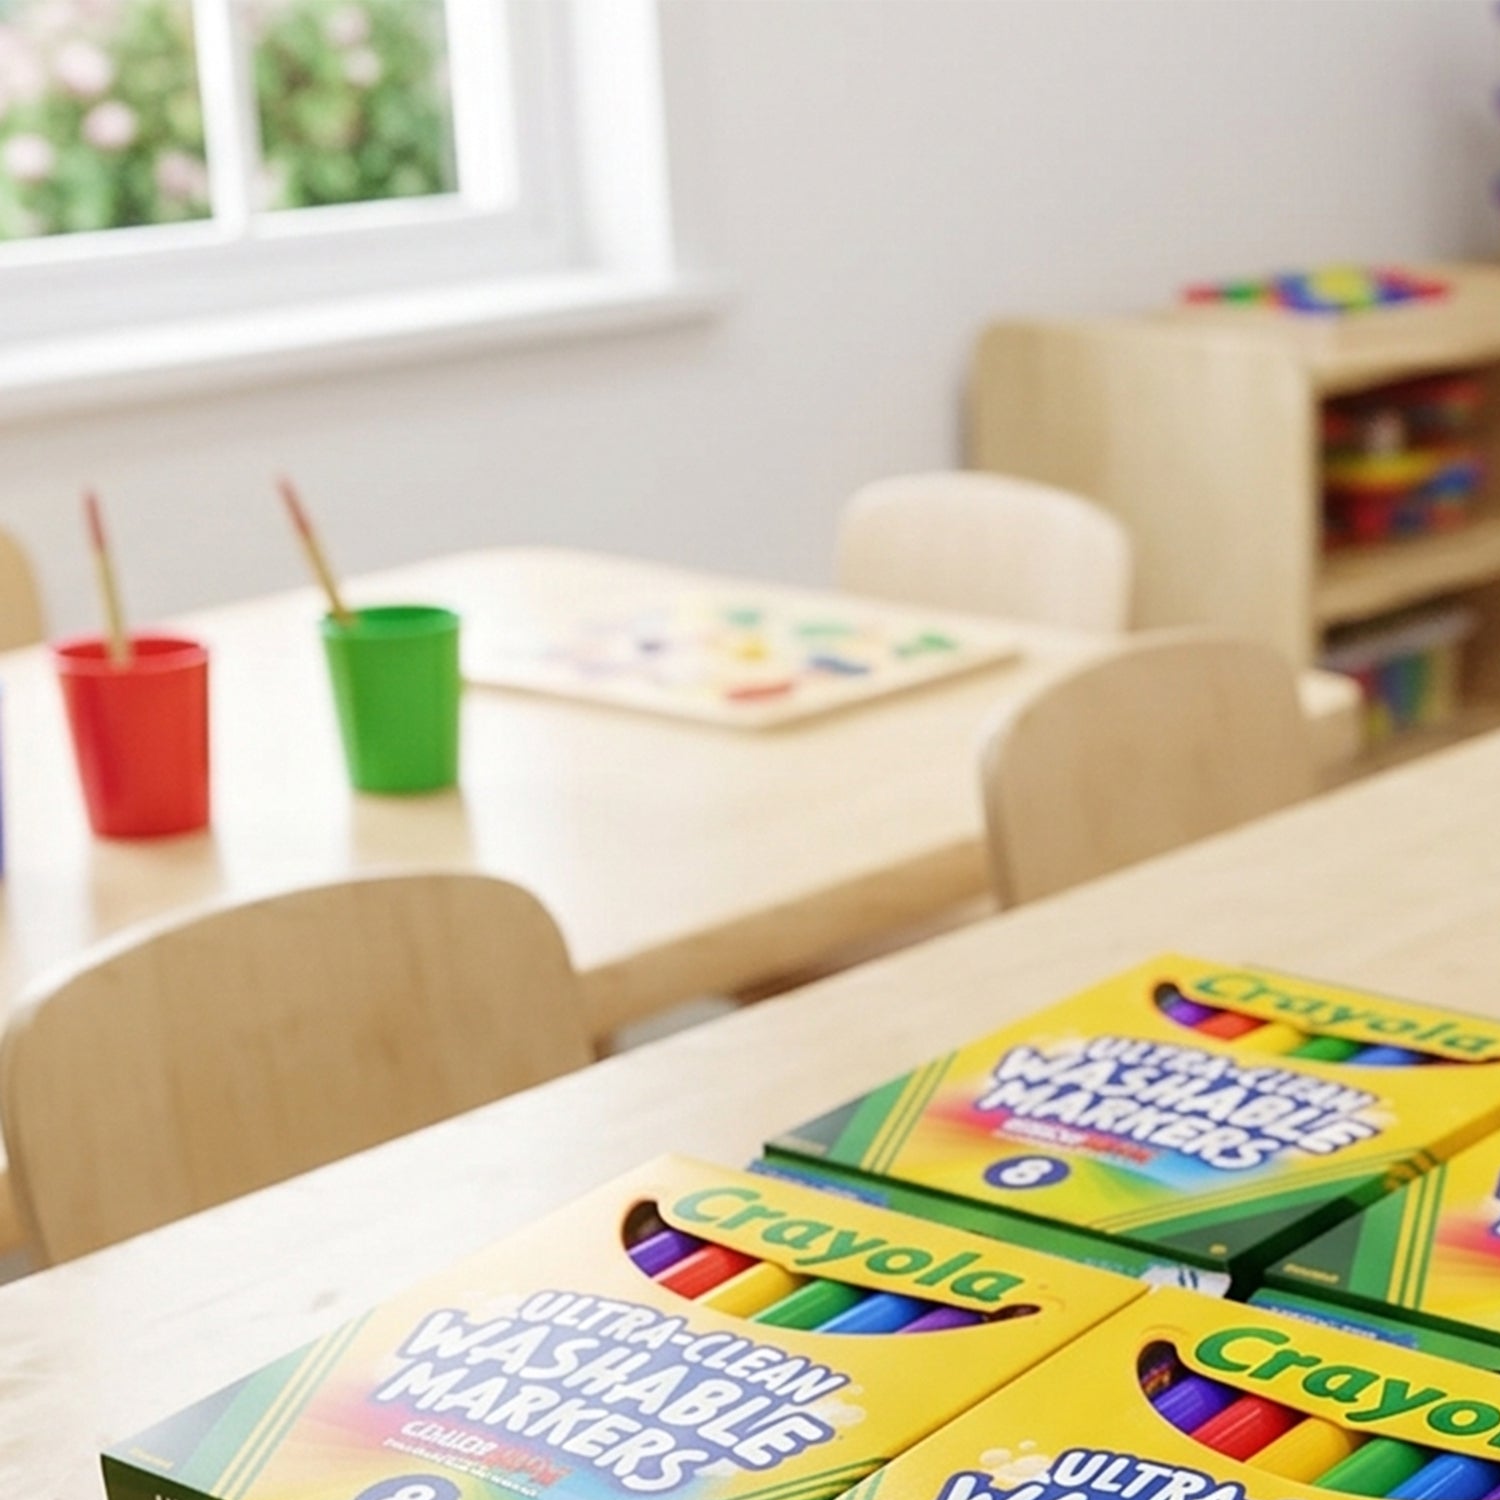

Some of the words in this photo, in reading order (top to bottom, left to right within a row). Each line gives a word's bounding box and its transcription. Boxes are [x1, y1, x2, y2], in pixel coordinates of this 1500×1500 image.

[1194, 973, 1497, 1053] Crayola
[978, 1082, 1278, 1170] MARKERS
[998, 1049, 1376, 1155] WASHABLE
[1000, 1159, 1053, 1186] 8
[671, 1187, 1026, 1303] Crayola
[409, 1310, 826, 1468] WASHABLE
[519, 1292, 847, 1403] ULTRA-CLEAN
[377, 1362, 702, 1493] MARKERS
